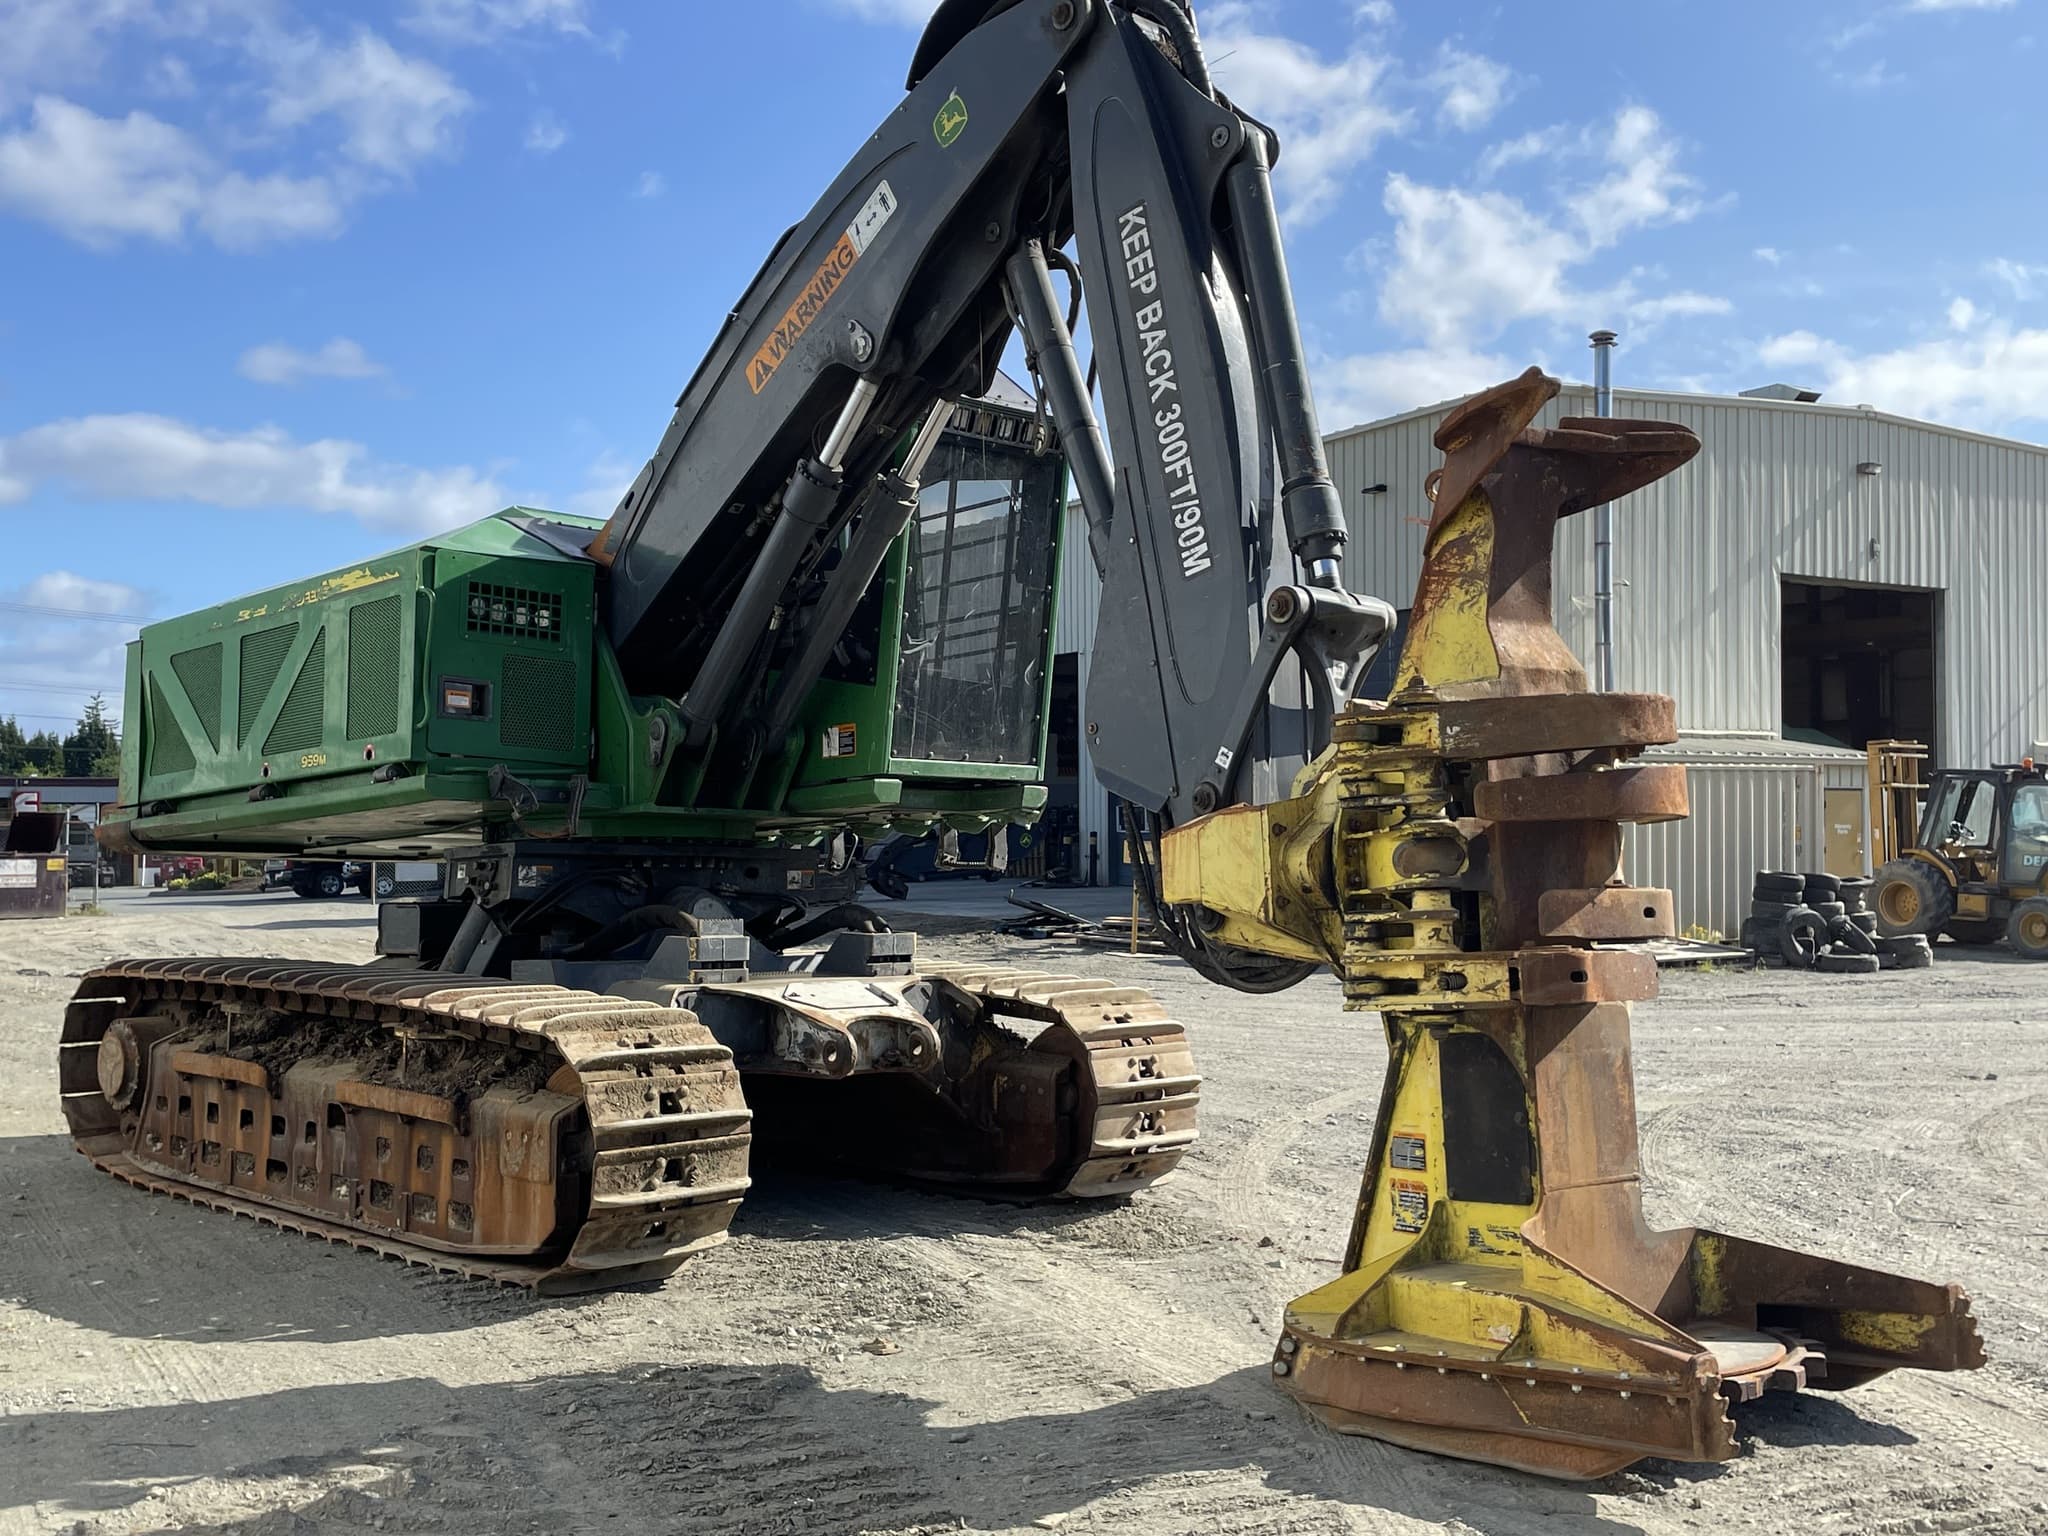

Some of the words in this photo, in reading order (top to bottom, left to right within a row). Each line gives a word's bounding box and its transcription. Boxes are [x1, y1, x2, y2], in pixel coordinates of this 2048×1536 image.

[1118, 205, 1158, 294] KEEP
[767, 244, 854, 362] WARNING
[1135, 299, 1177, 403] BACK
[1154, 402, 1212, 577] 300FT/90M
[301, 754, 327, 768] 959M
